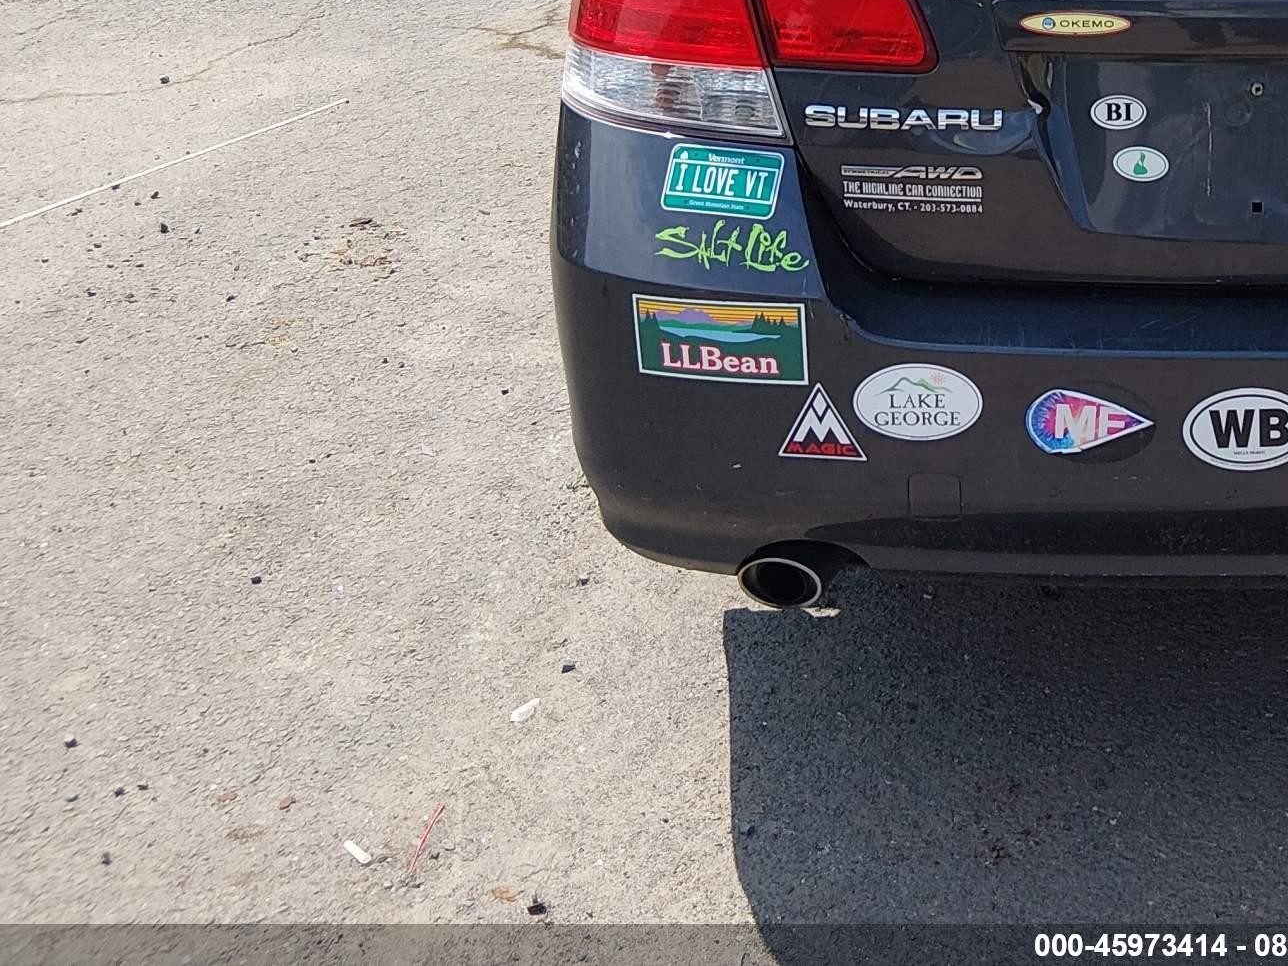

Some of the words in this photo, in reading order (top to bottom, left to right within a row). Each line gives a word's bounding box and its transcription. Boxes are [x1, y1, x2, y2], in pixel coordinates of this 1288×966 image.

[1059, 20, 1115, 28] OKEMO
[804, 104, 1004, 132] SUBARU
[1105, 102, 1133, 122] BI
[708, 153, 745, 165] Vermont
[894, 166, 983, 180] AWD
[675, 164, 688, 191] I
[692, 165, 739, 197] LOVE
[745, 170, 769, 199] VT
[905, 184, 924, 196] CAR
[844, 199, 895, 212] Waterbury,
[888, 394, 946, 410] LAKE
[874, 410, 961, 428] GEORGE
[786, 442, 859, 456] MAGIC
